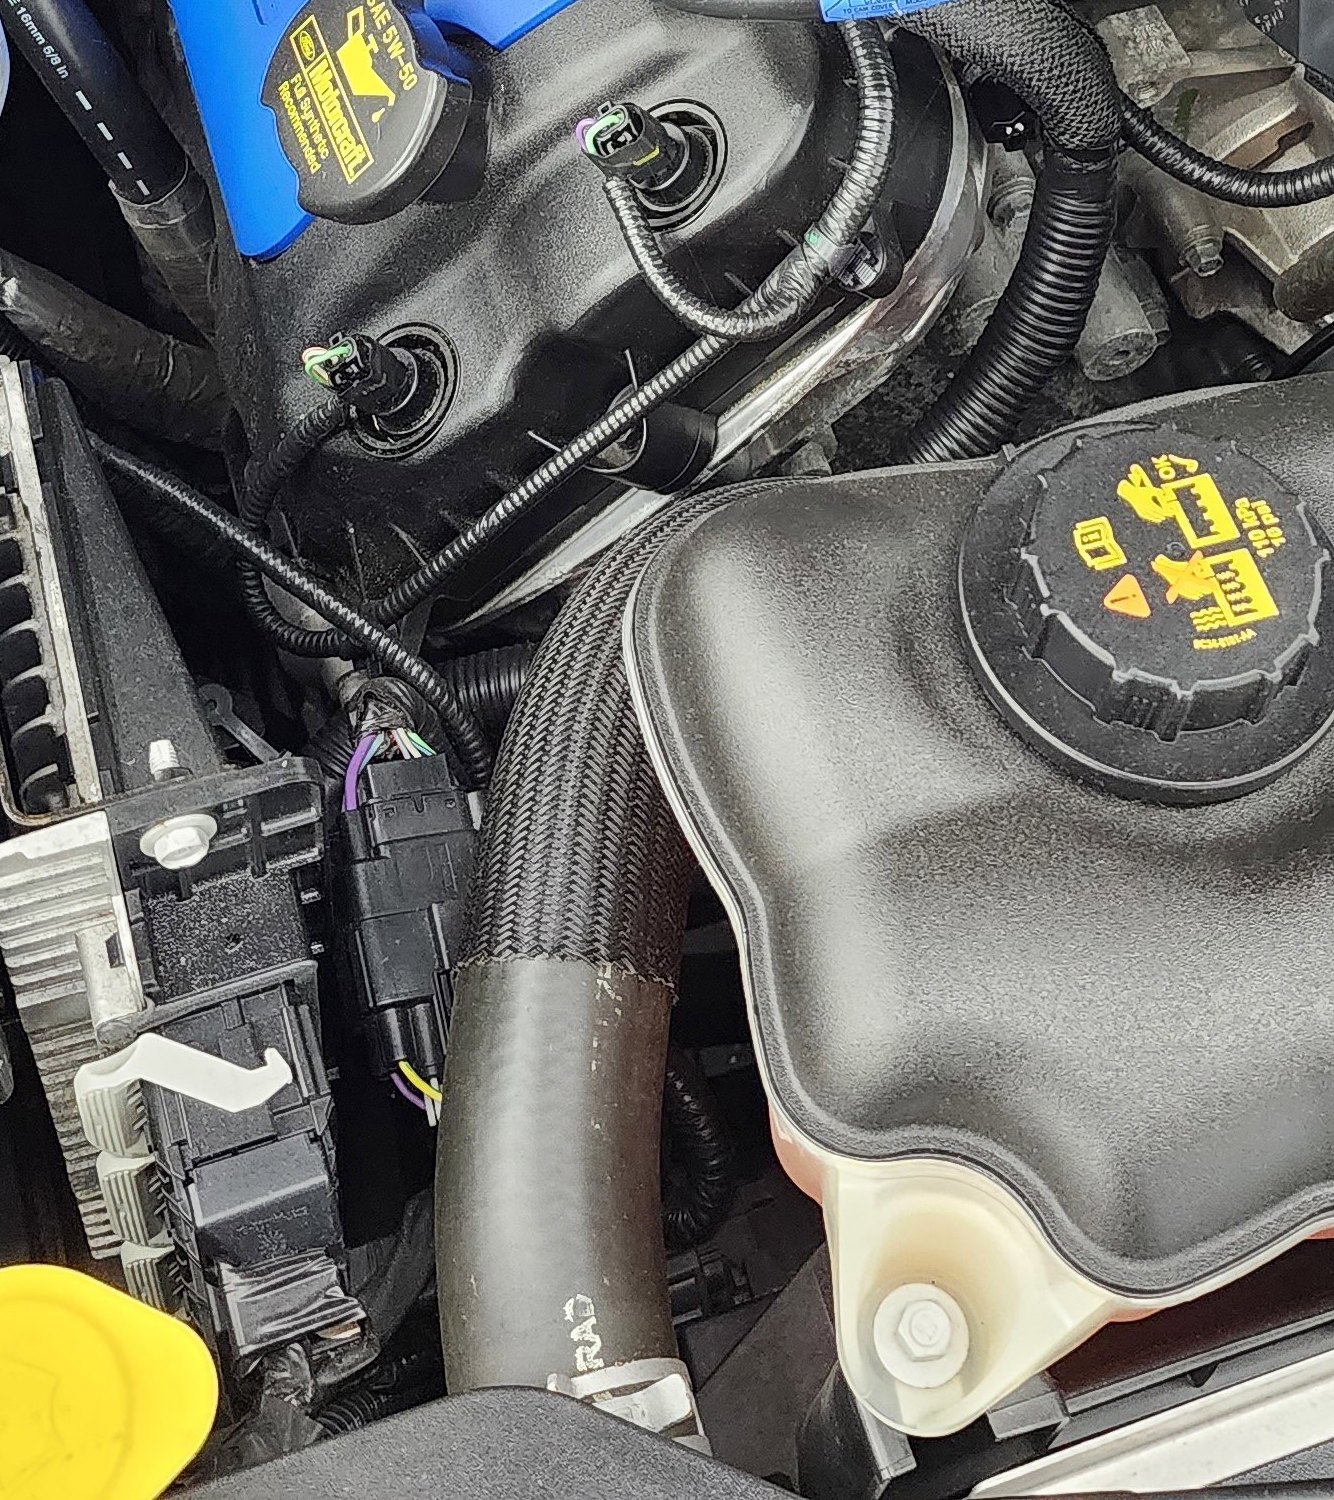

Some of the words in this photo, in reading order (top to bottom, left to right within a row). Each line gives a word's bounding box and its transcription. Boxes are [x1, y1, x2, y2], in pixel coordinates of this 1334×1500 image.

[16, 6, 46, 46] 16mm
[382, 24, 418, 91] 5W-50
[277, 80, 322, 175] Recommended
[300, 97, 329, 160] Synthetic
[307, 56, 368, 179] Motorcraft
[1150, 453, 1176, 481] OK
[1247, 528, 1275, 559] 110
[1265, 526, 1287, 547] 16
